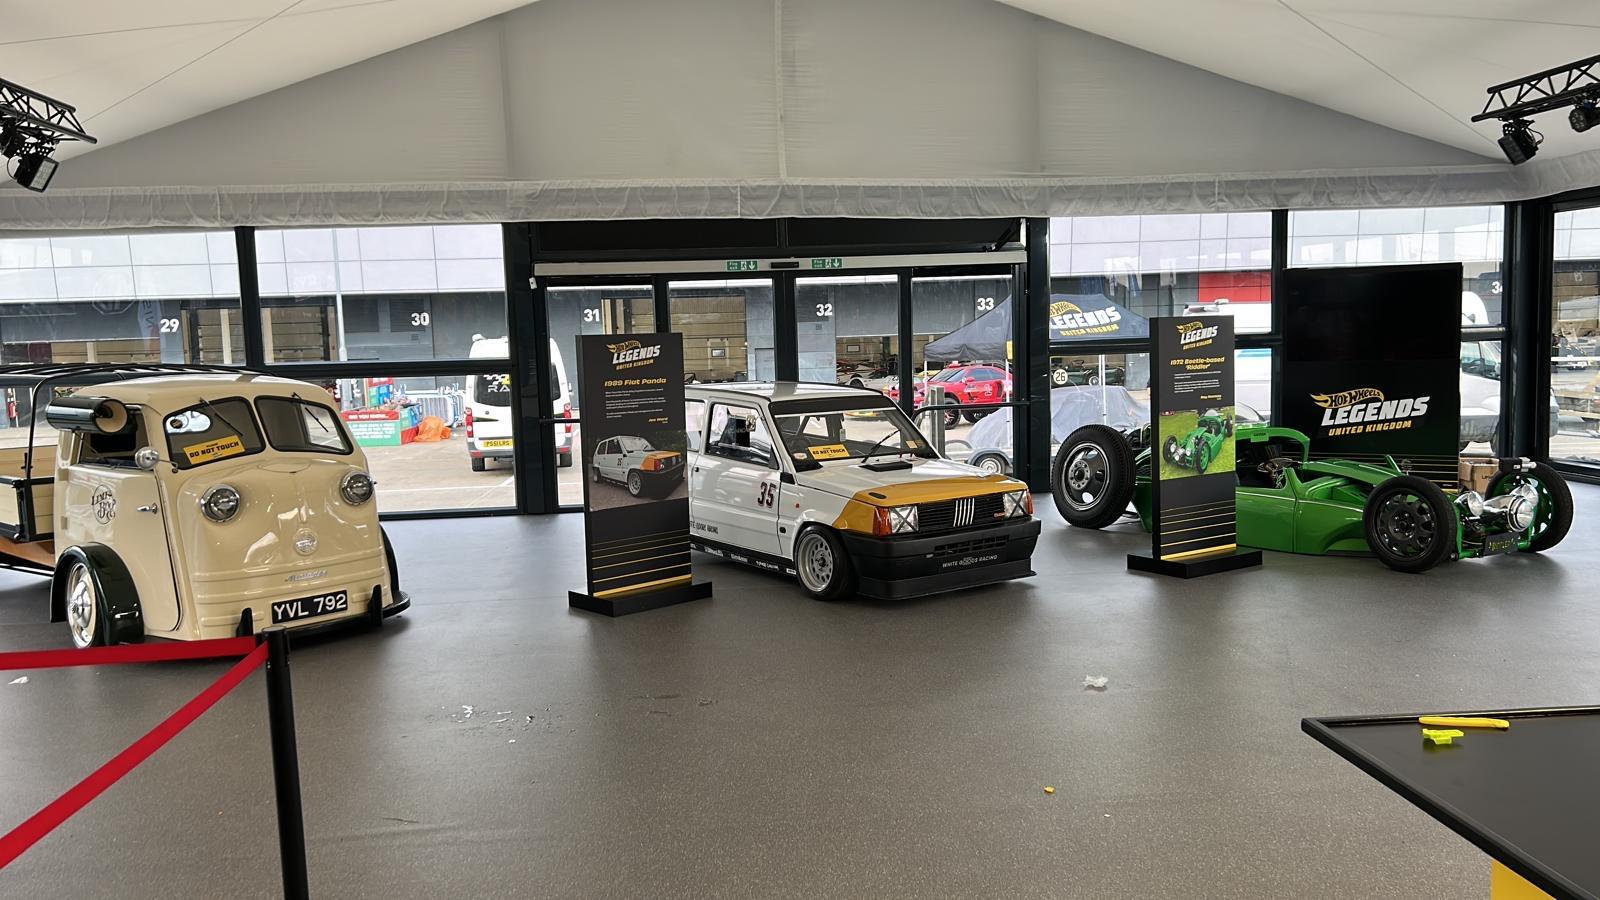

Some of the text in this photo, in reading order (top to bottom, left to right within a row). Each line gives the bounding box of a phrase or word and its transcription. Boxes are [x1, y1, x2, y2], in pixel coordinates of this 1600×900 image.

[816, 303, 833, 317] 32
[977, 298, 994, 311] 33
[411, 312, 430, 326] 30
[583, 308, 600, 322] 31
[160, 318, 180, 333] 29
[1180, 326, 1219, 344] LEGENDS
[612, 345, 661, 364] LEGENDS
[1184, 356, 1225, 364] Beetle-based
[1055, 371, 1067, 382] 26
[1321, 396, 1430, 426] LEGENDS
[1328, 420, 1412, 436] UNITED KINGDOM
[216, 441, 239, 450] TOUCH
[757, 481, 777, 507] 35
[942, 560, 958, 568] WHITE
[273, 593, 346, 620] YVL 792
